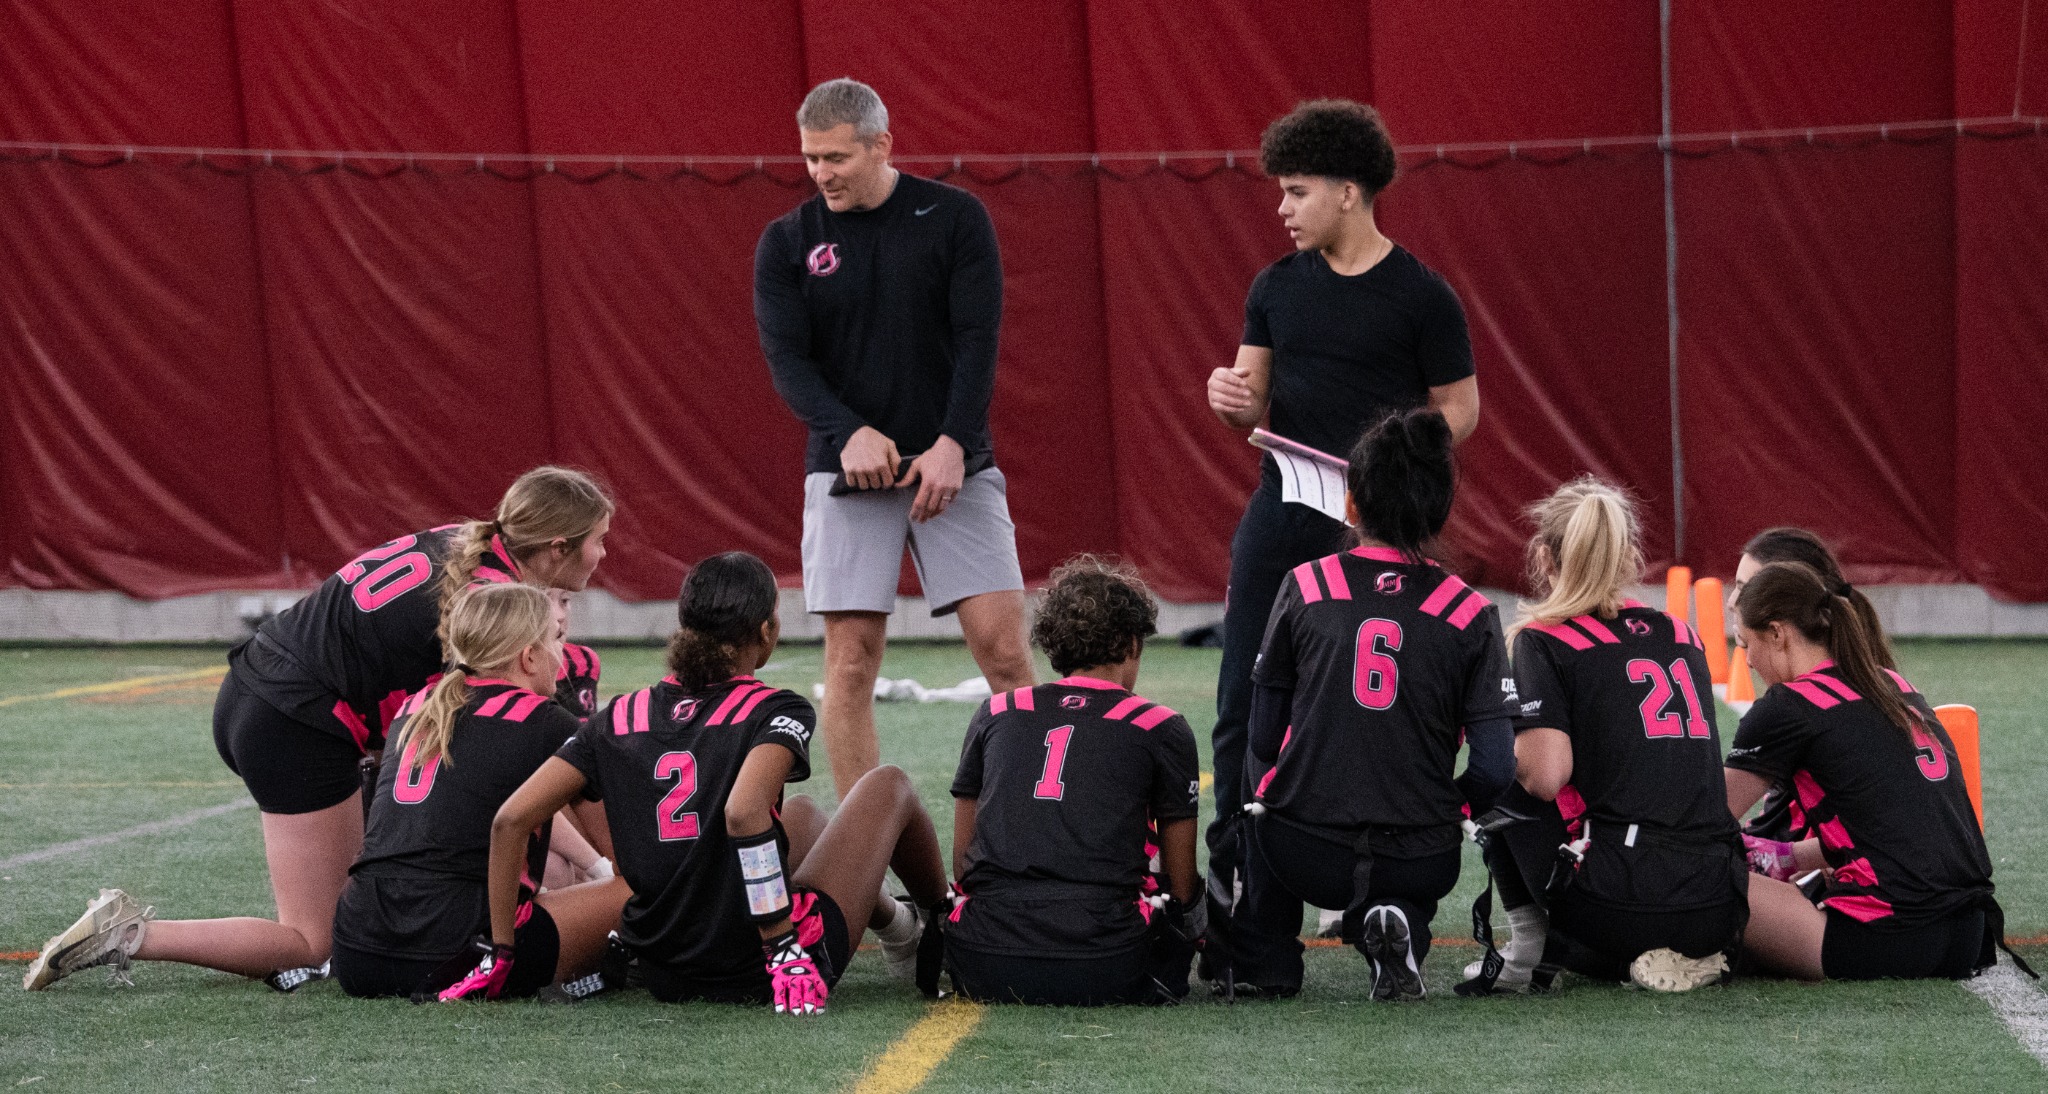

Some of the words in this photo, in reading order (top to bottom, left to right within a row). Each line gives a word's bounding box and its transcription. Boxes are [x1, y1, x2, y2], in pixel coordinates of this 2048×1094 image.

[336, 533, 433, 613] 20
[1353, 617, 1403, 710] 6
[1626, 658, 1712, 739] 21
[654, 750, 701, 841] 2
[1034, 724, 1074, 802] 1
